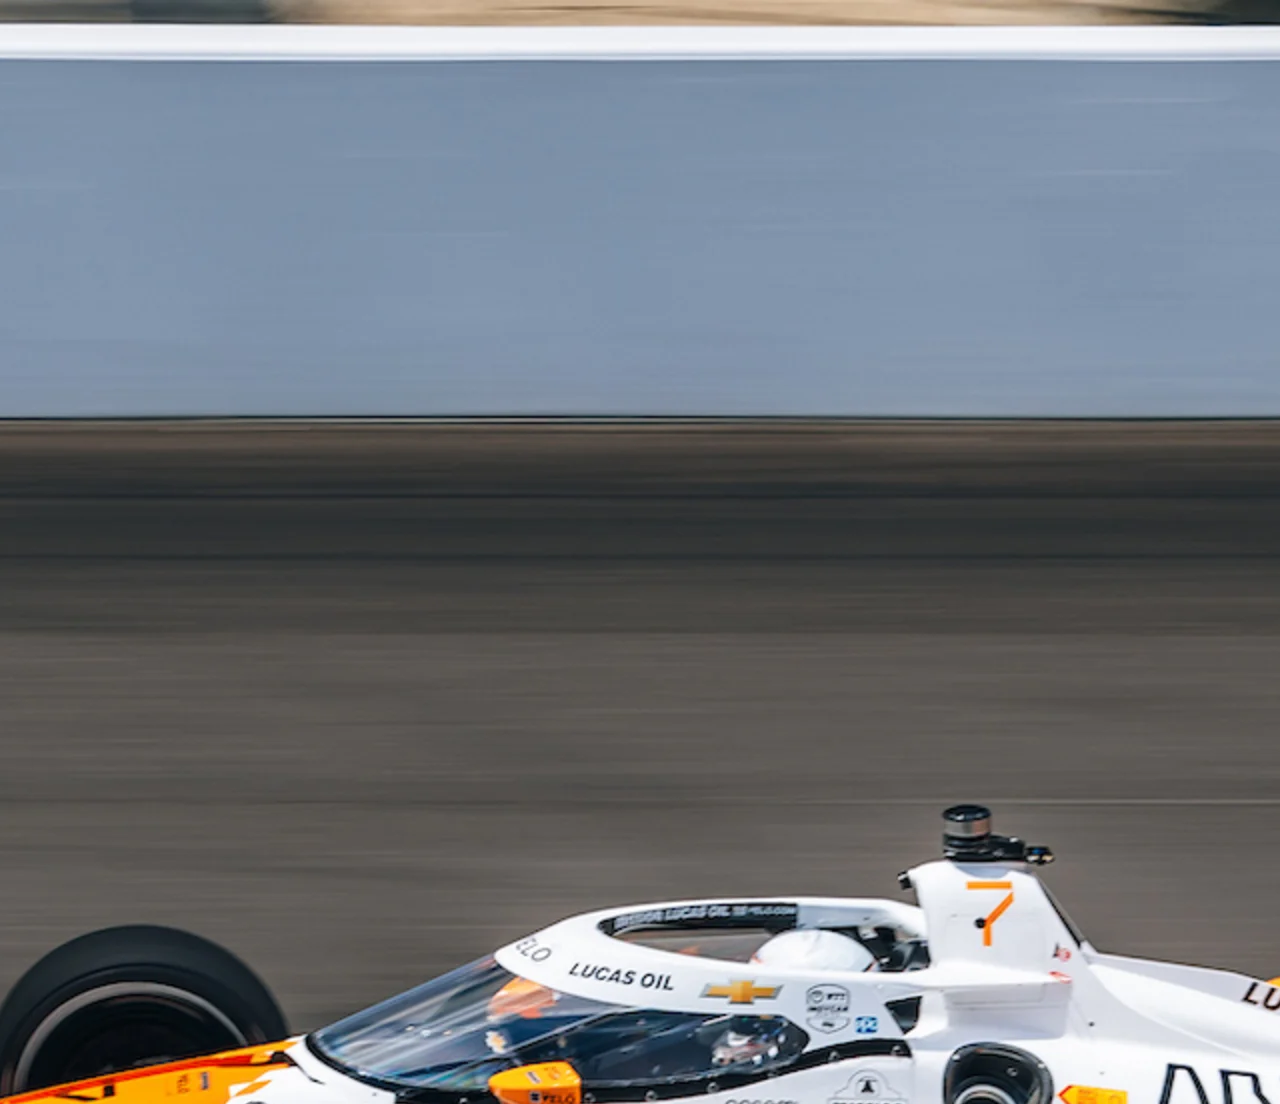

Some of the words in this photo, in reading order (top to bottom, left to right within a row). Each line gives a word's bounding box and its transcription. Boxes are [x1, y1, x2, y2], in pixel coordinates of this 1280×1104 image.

[966, 881, 1015, 947] 7
[515, 937, 553, 963] ELO
[568, 962, 637, 986] LUCAS
[640, 972, 675, 991] OIL
